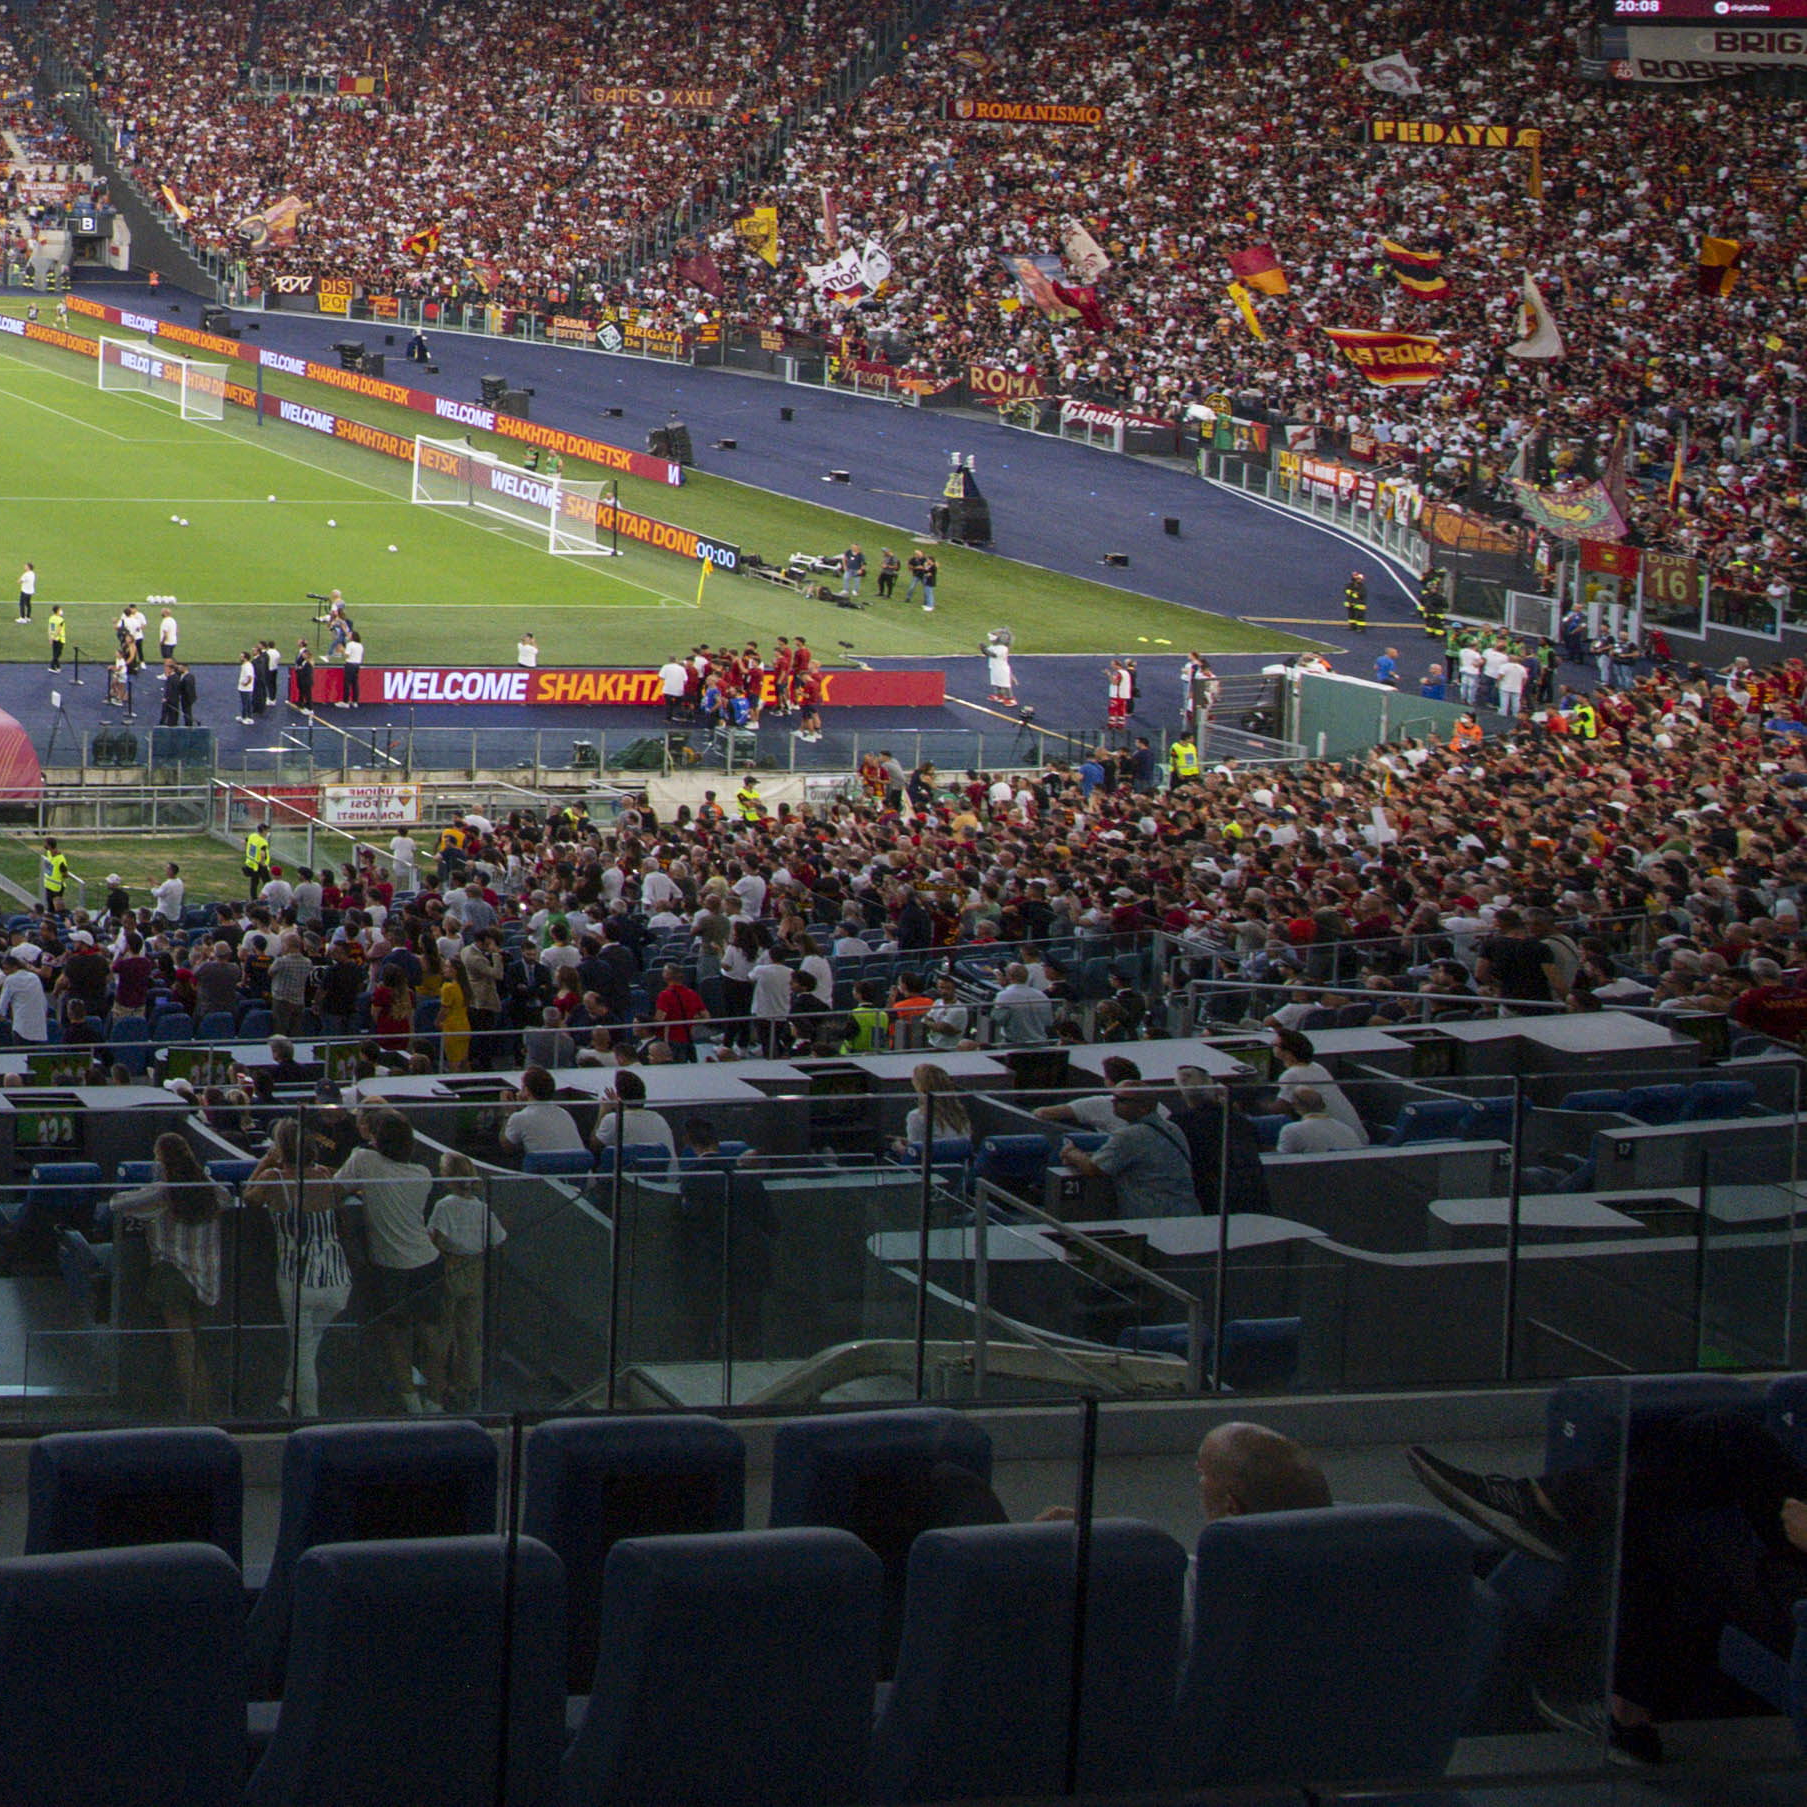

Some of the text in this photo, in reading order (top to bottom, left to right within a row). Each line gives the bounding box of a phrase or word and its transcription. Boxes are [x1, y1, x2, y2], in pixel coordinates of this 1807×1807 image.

[1615, 0, 1660, 12] 20:08
[1715, 31, 1807, 55] BRIG
[593, 88, 714, 106] GATE XXII
[976, 102, 1102, 123] ROMANISMO
[1374, 121, 1509, 146] FEDAYN
[82, 217, 94, 231] B
[25, 322, 65, 347] SHAKHTAR
[121, 312, 241, 358] WELCOME SHAKHTAR DONETSK
[625, 325, 683, 343] BRIGATA
[259, 349, 409, 405] WELCOME SHAKHTAR DONETSK
[970, 367, 1040, 396] ROMA
[280, 400, 333, 434] WELCOME
[335, 420, 397, 458] SHAKHTAR
[435, 398, 632, 472] WELCOME SHAKHTAR DONETSK
[491, 470, 563, 512] WELCOME
[695, 542, 736, 569] 00:00
[1647, 553, 1689, 567] DDR
[1650, 567, 1687, 601] 16
[383, 671, 529, 701] WELCOME
